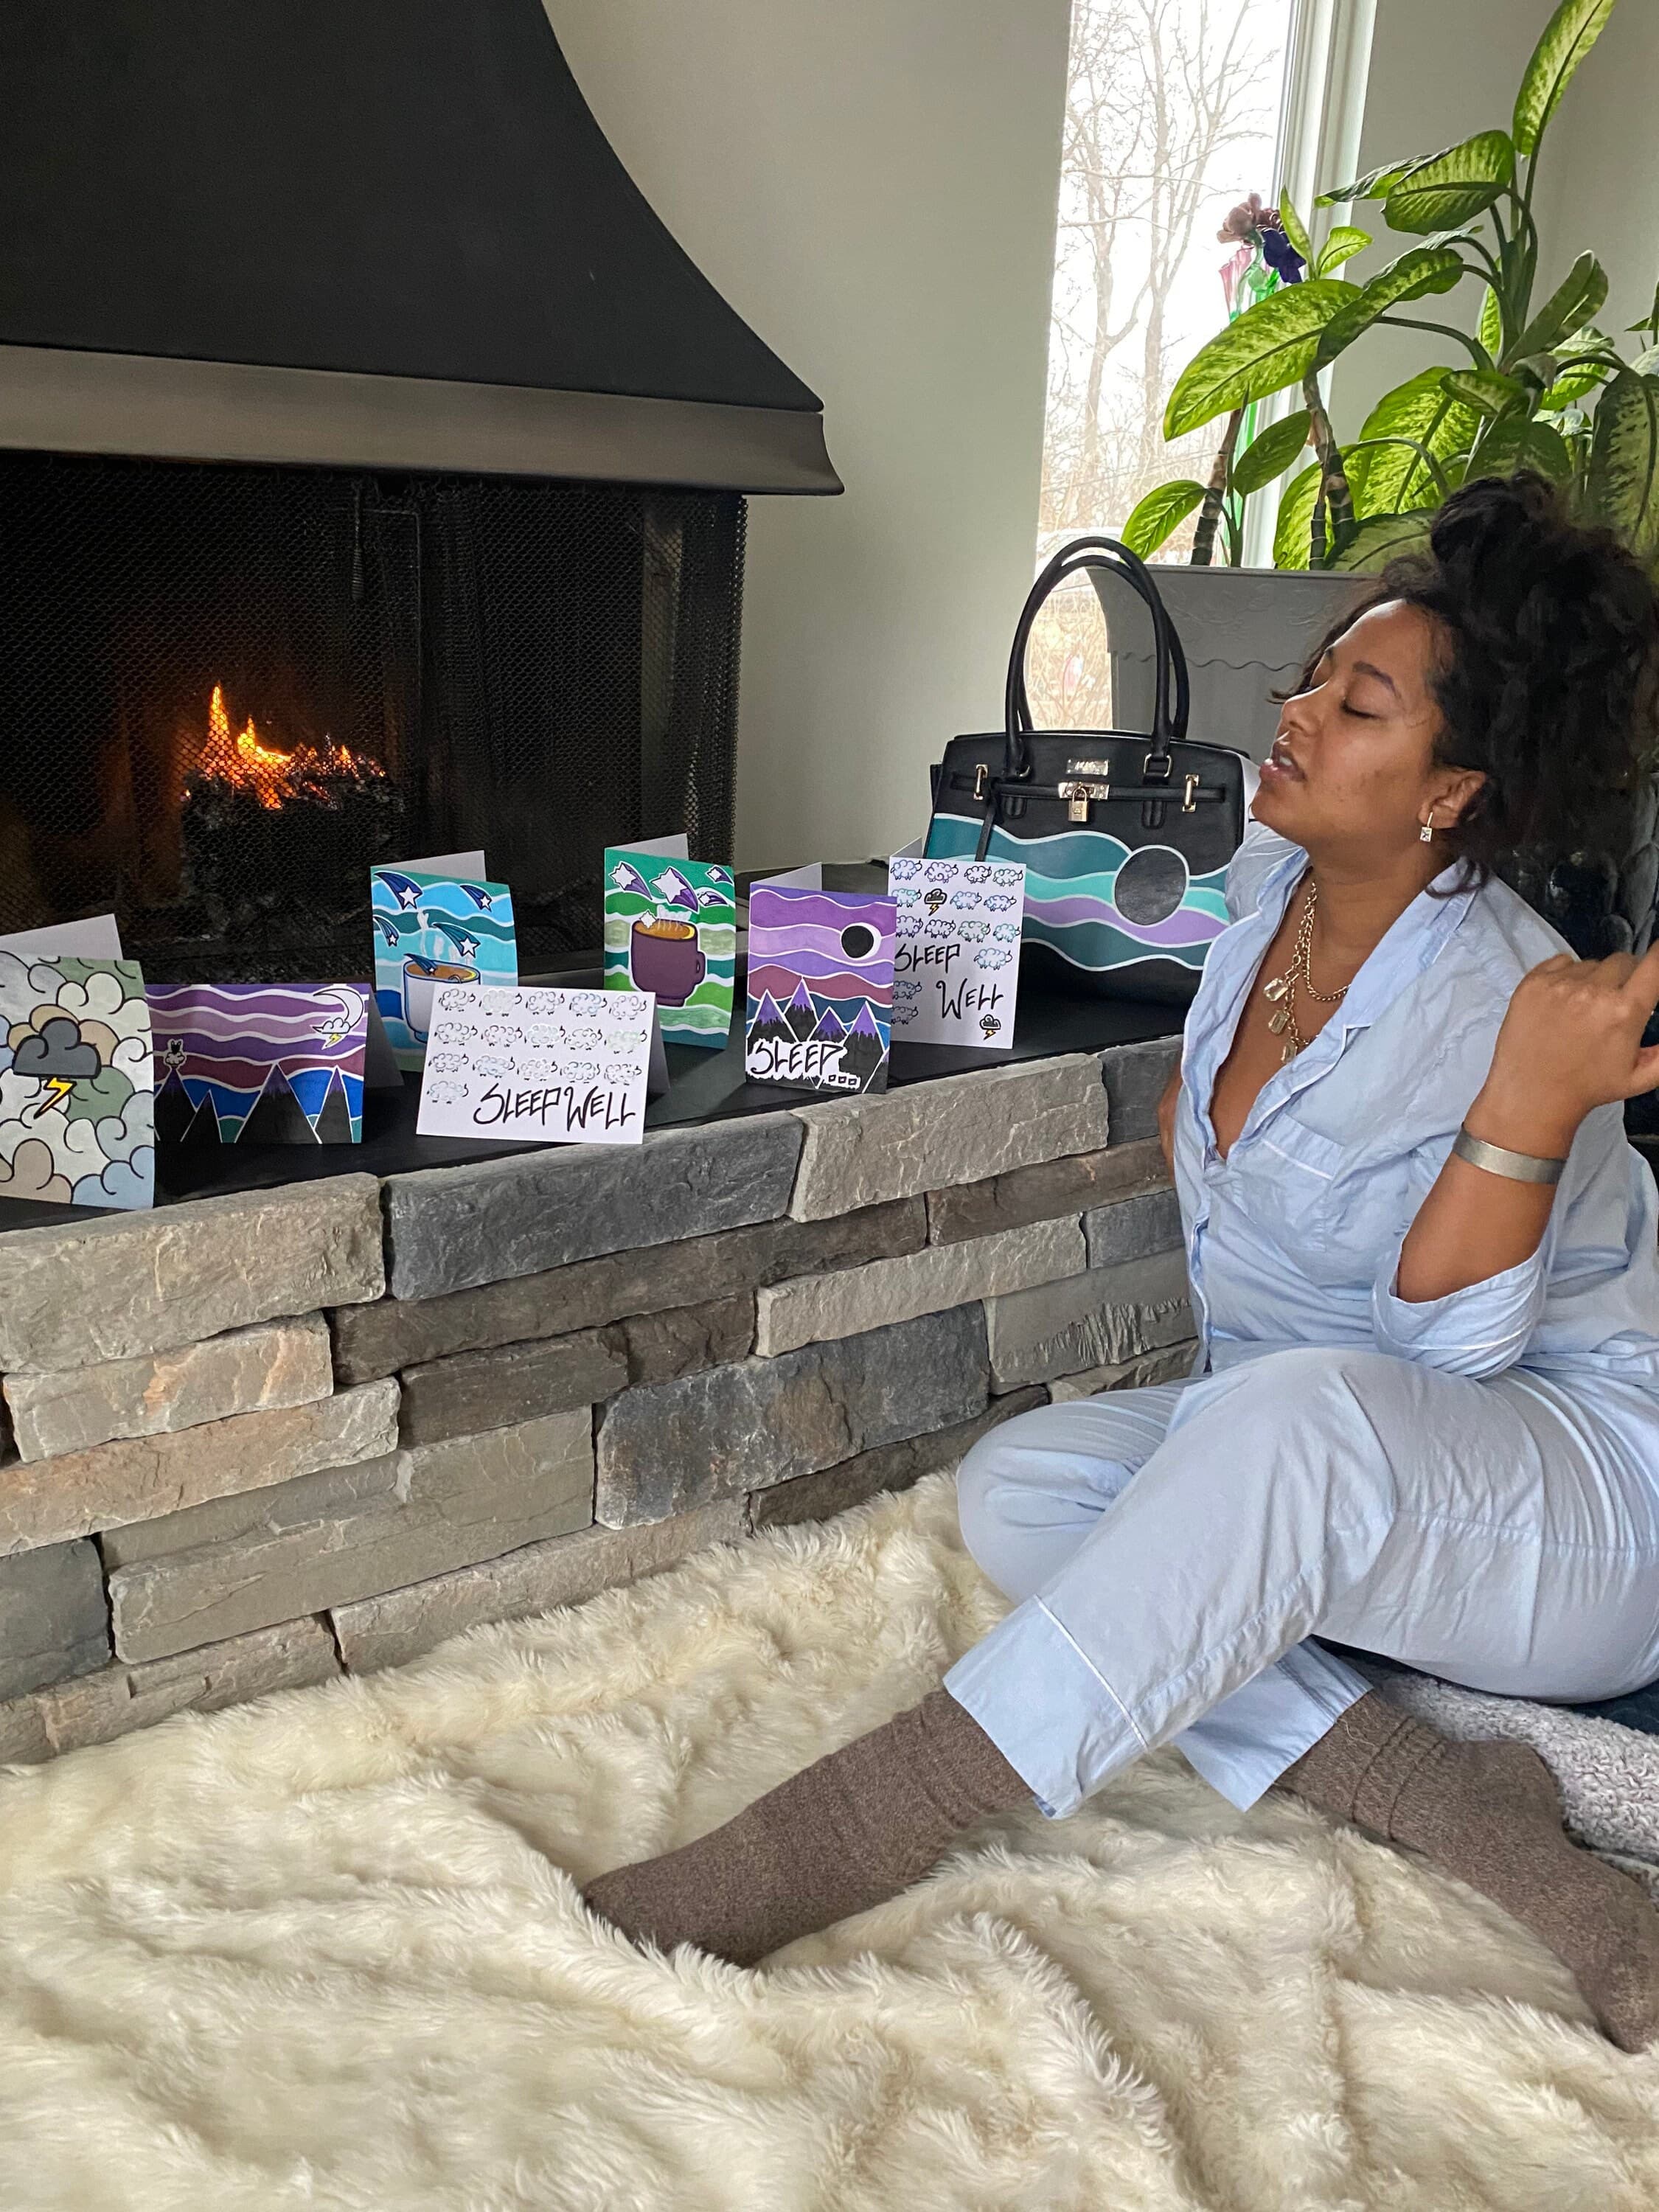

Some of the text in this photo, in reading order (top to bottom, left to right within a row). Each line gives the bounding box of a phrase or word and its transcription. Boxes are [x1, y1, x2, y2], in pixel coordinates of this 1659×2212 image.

[894, 943, 961, 974] SLEEP
[936, 978, 1004, 1020] WELL
[473, 1083, 636, 1132] SLEEP WELL
